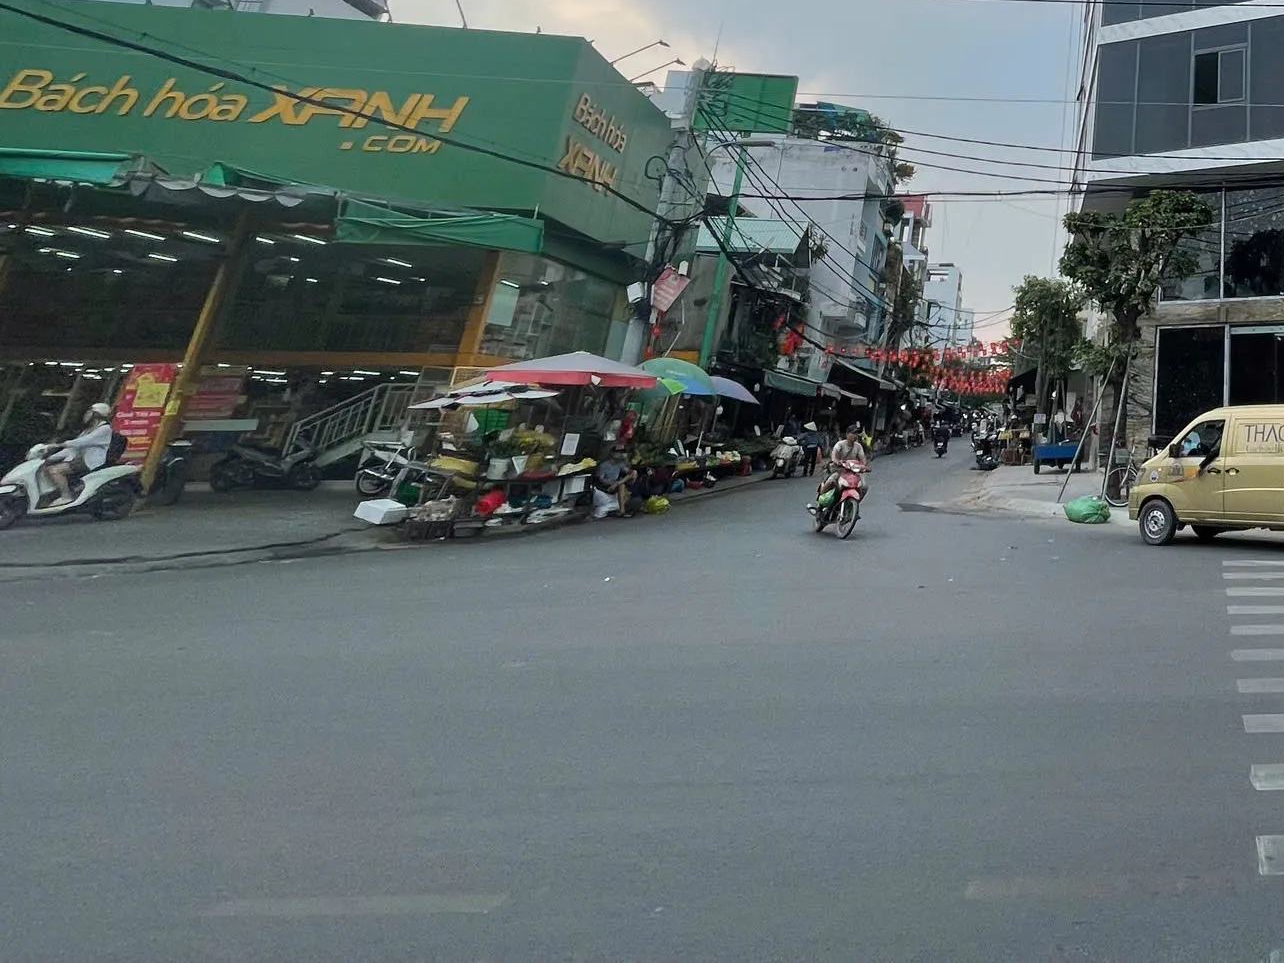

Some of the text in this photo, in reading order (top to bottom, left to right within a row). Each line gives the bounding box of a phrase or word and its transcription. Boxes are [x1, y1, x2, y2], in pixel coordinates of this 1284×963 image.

[0, 68, 469, 134] Bách hóa XANH
